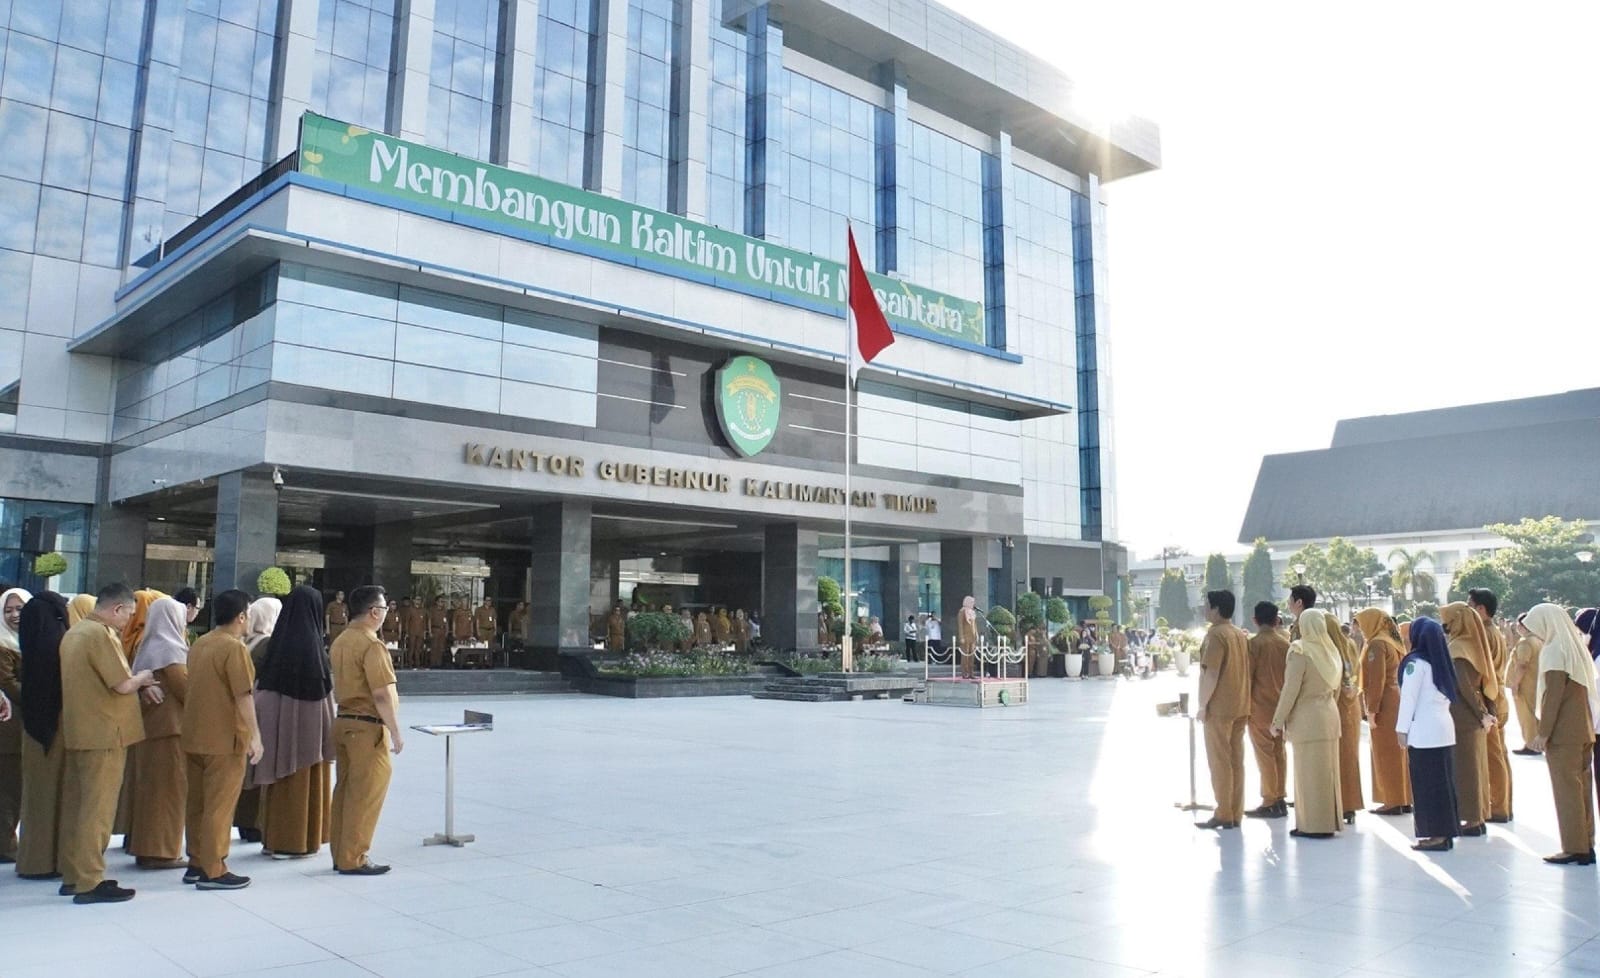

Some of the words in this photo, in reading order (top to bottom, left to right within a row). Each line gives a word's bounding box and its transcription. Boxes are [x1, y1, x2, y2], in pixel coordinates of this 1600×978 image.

[369, 139, 621, 244] Membangun
[631, 210, 737, 274] Kaltim
[746, 242, 830, 298] Untuk
[838, 269, 963, 333] Nsantara
[464, 442, 585, 478] KANTOR
[599, 460, 731, 493] GUBERNUR
[883, 493, 937, 513] TIMUR
